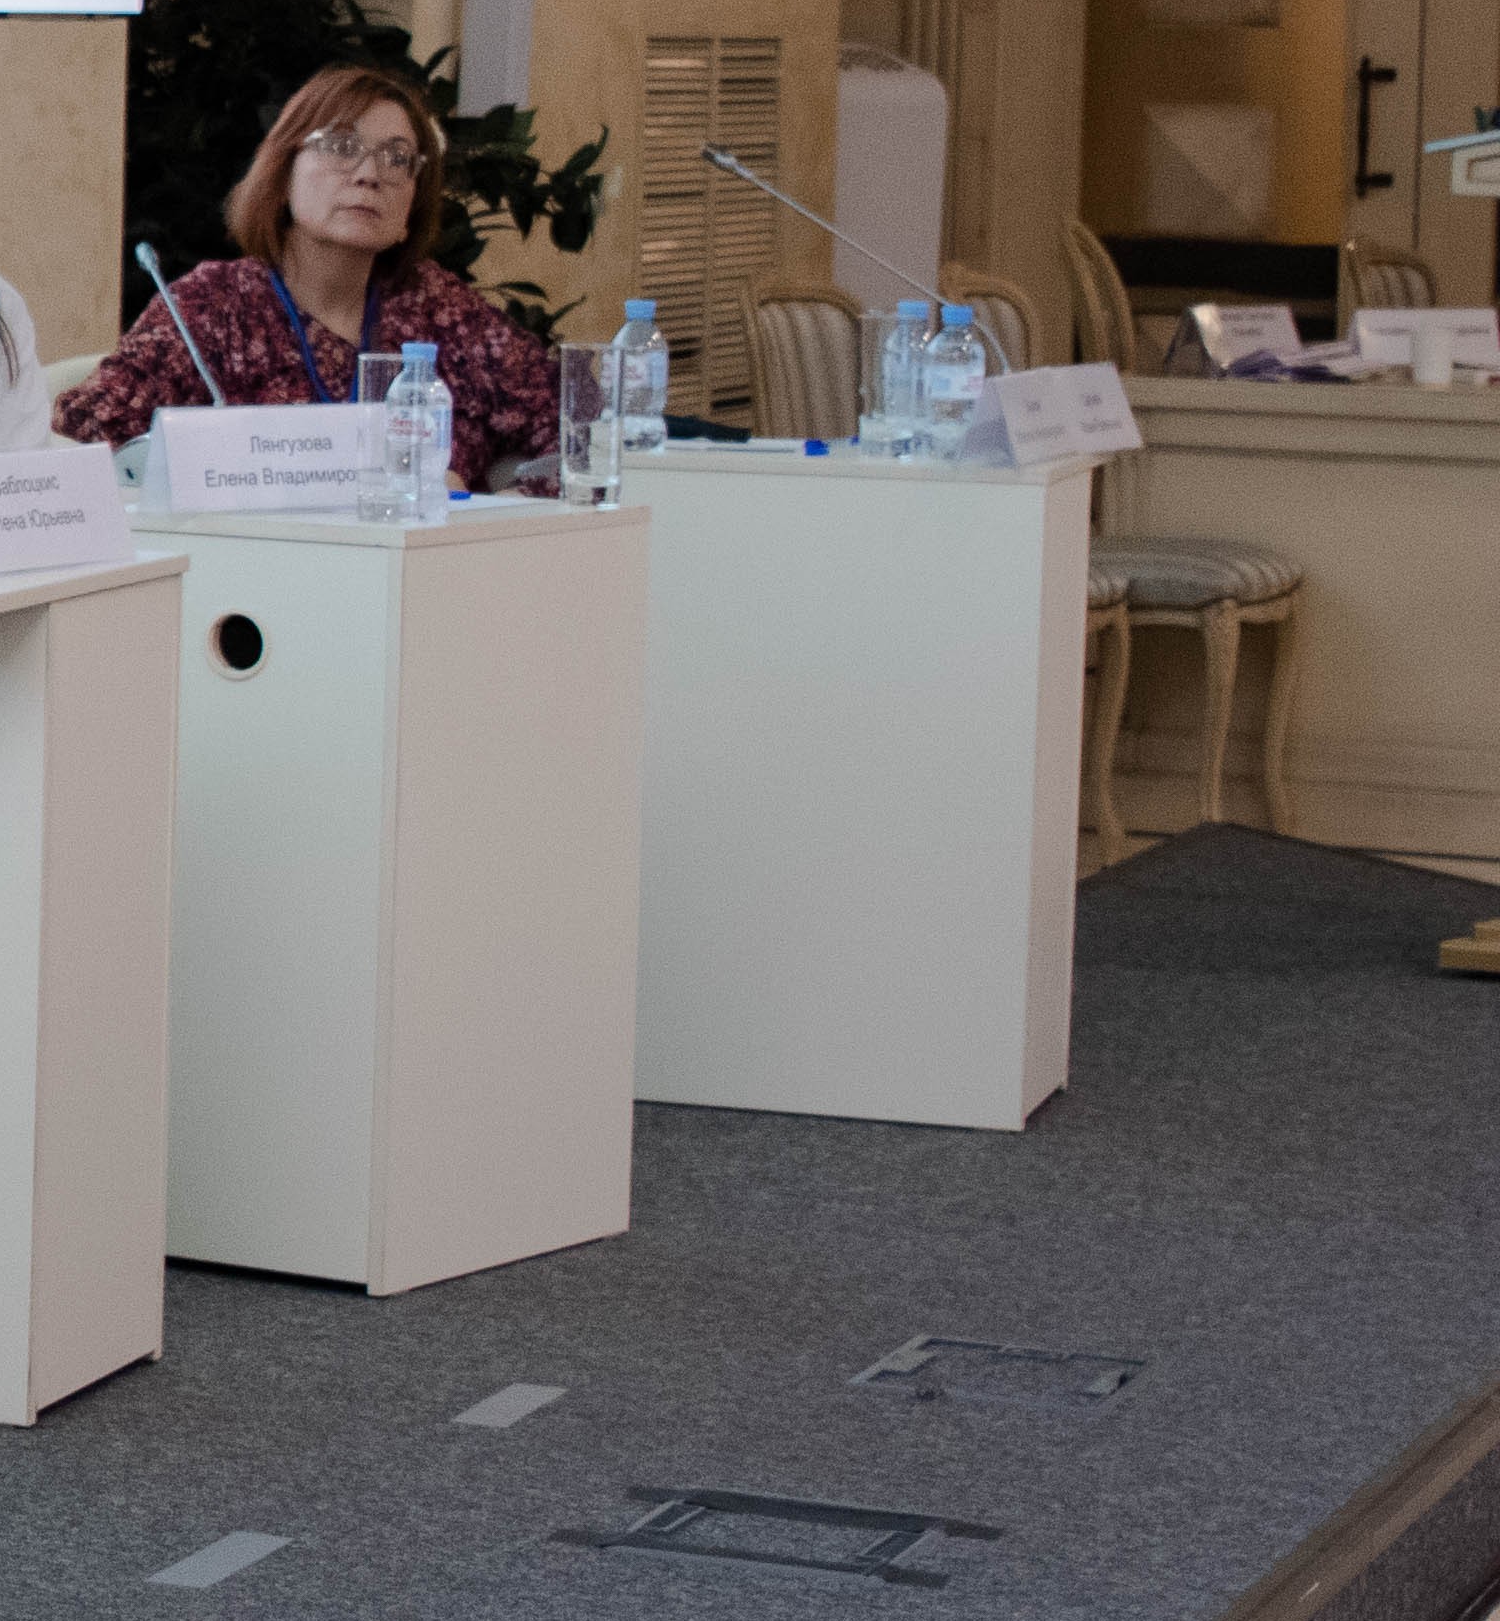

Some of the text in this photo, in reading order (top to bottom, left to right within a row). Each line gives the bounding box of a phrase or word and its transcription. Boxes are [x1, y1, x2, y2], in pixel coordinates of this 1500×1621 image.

[250, 436, 332, 456] Лянгузова
[204, 468, 258, 489] Елена
[28, 508, 86, 531] Юрьевна
